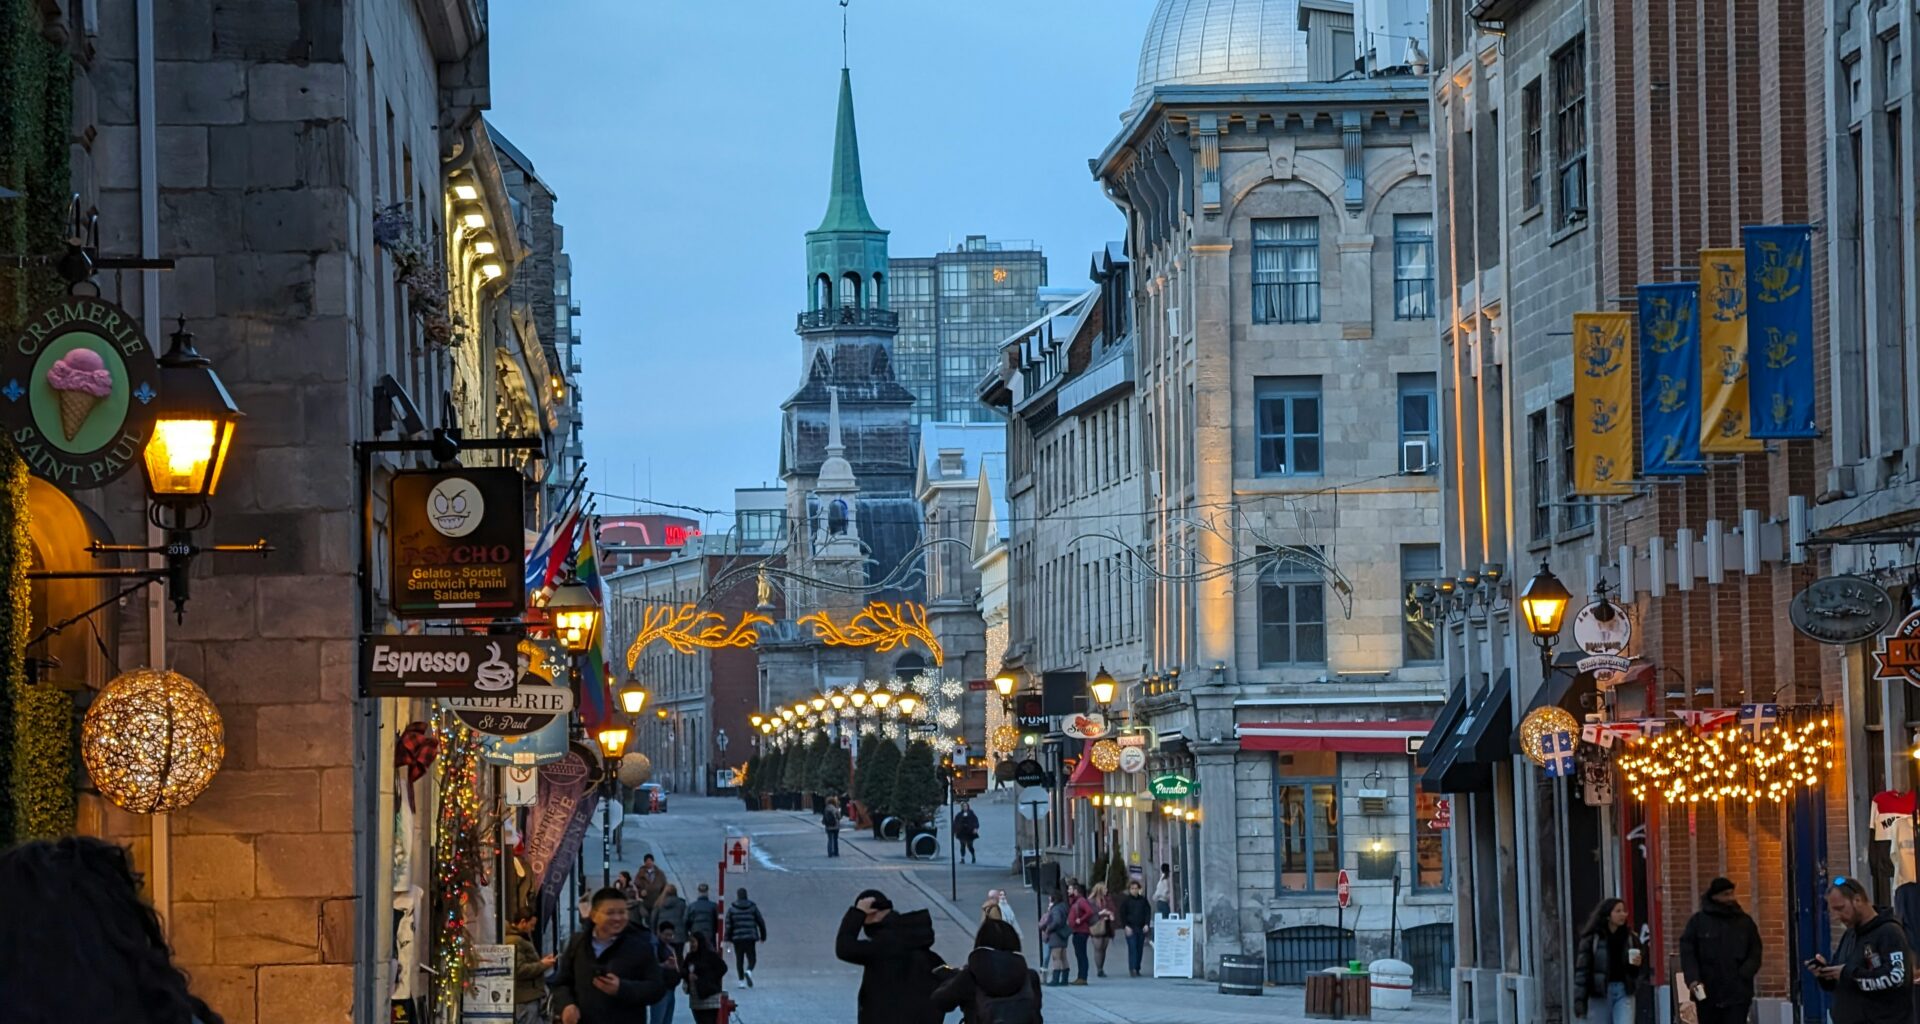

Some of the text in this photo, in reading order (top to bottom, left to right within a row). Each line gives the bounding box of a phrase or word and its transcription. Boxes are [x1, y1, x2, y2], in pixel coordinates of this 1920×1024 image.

[18, 302, 144, 357] CREMERIE
[14, 426, 144, 485] SAINT PAUL
[168, 545, 190, 556] 2019
[402, 544, 511, 565] PSYCHO
[412, 568, 452, 579] Gelato
[462, 567, 503, 578] Sorbet
[407, 577, 507, 591] Sandwich Panini
[433, 589, 481, 601] Salades
[1903, 619, 1920, 636] MO
[371, 645, 470, 678] Espresso
[478, 714, 532, 730] St-Paul
[1019, 715, 1048, 724] YUMI
[1155, 781, 1188, 794] Paradiso
